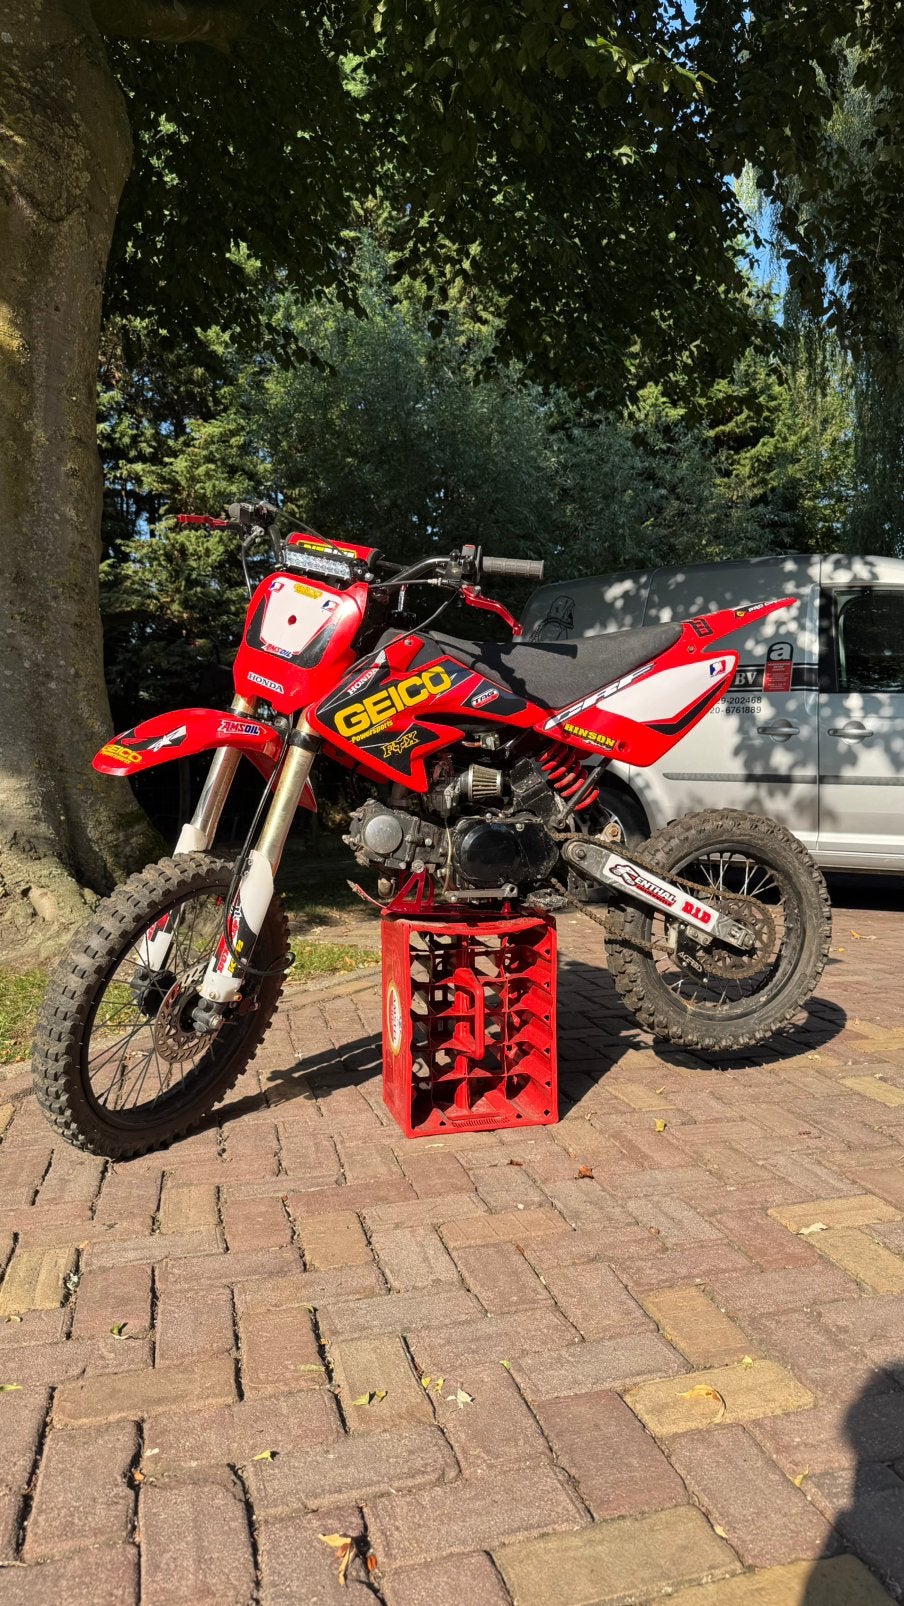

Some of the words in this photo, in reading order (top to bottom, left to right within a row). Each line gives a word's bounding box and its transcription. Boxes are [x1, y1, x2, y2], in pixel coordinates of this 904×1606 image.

[248, 673, 283, 692] HONDA
[346, 668, 379, 696] HONDA
[734, 671, 757, 685] BV
[334, 665, 452, 737] GEICO
[218, 720, 260, 735] AMSOIL
[351, 719, 394, 744] Powersports
[564, 723, 616, 747] HINSON
